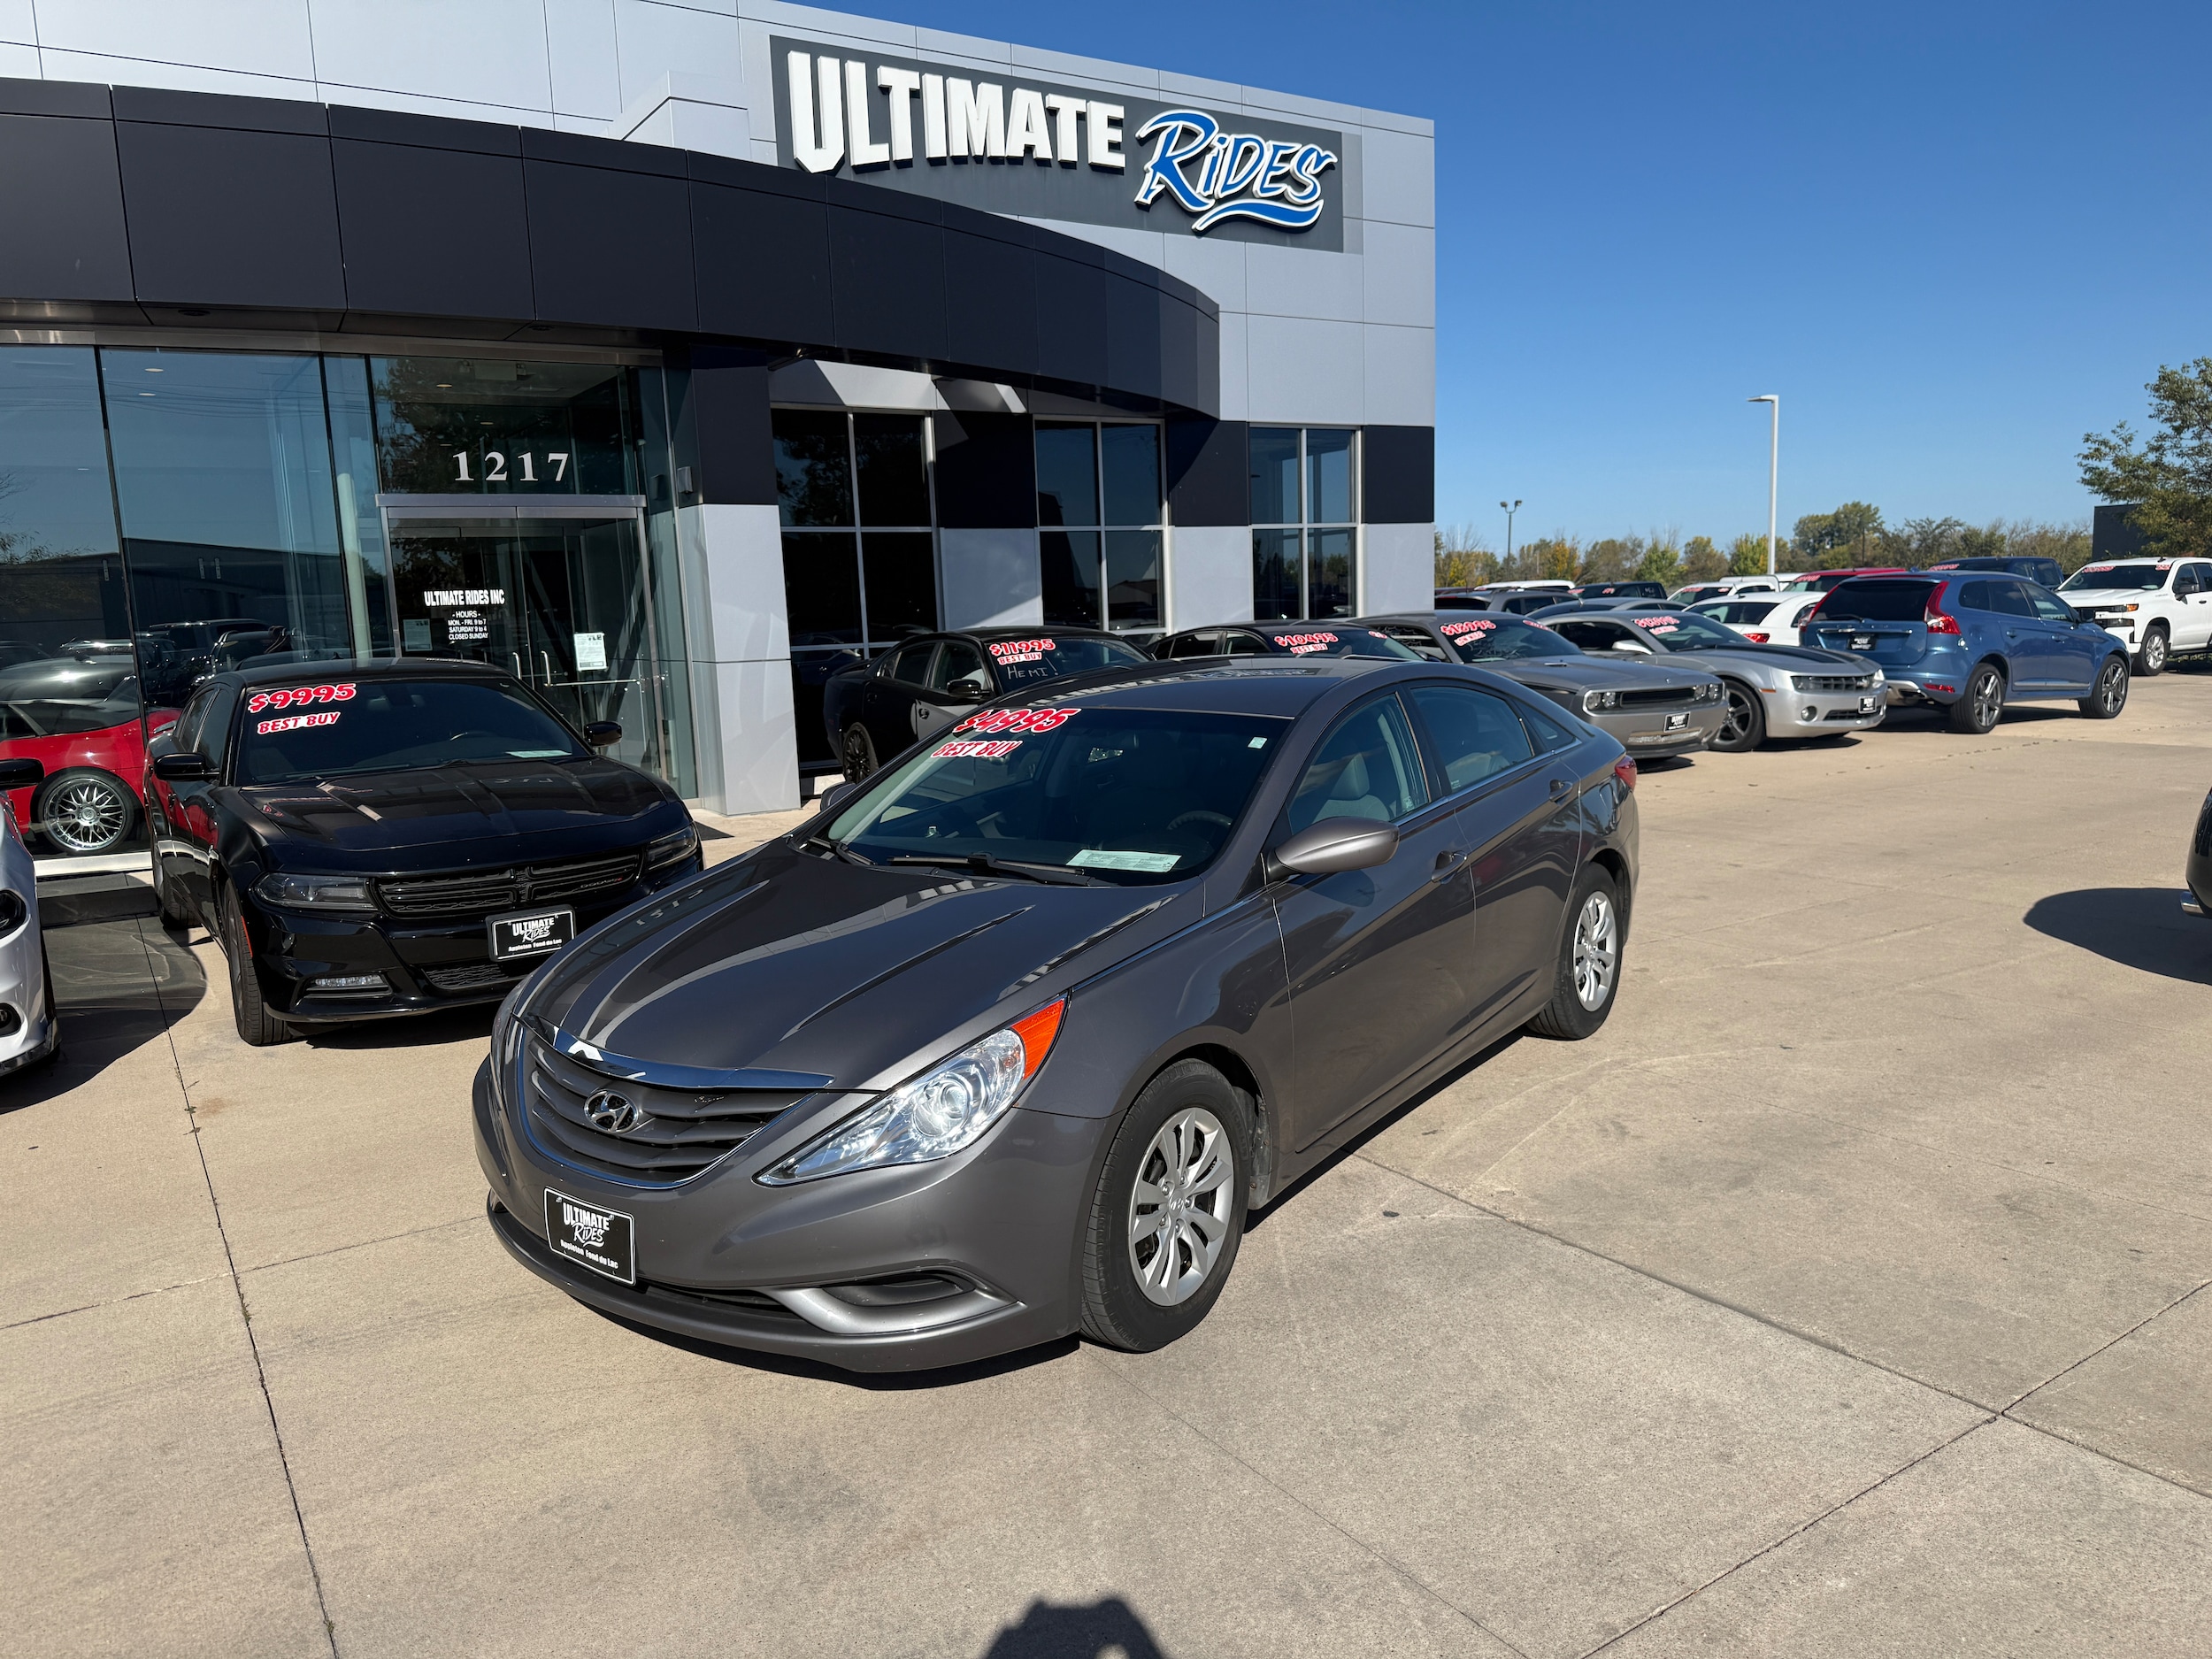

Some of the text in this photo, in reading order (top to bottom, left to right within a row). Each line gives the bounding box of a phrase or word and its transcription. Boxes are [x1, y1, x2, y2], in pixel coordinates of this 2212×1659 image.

[787, 50, 1125, 174] ULTIMATE
[452, 450, 569, 481] 1217
[424, 589, 505, 606] ULTIMATE RIDES INC
[989, 639, 1056, 656] $11995
[997, 652, 1042, 665] BEST BUY
[248, 683, 356, 713] $9995
[258, 712, 340, 733] BEST BUY
[952, 708, 1081, 733] $4995
[931, 741, 1023, 757] BEST BUY
[512, 918, 555, 936] ULTIMATE
[563, 1202, 610, 1231] ULTIMATE
[560, 1239, 618, 1269] Appleton Fond du Lac
